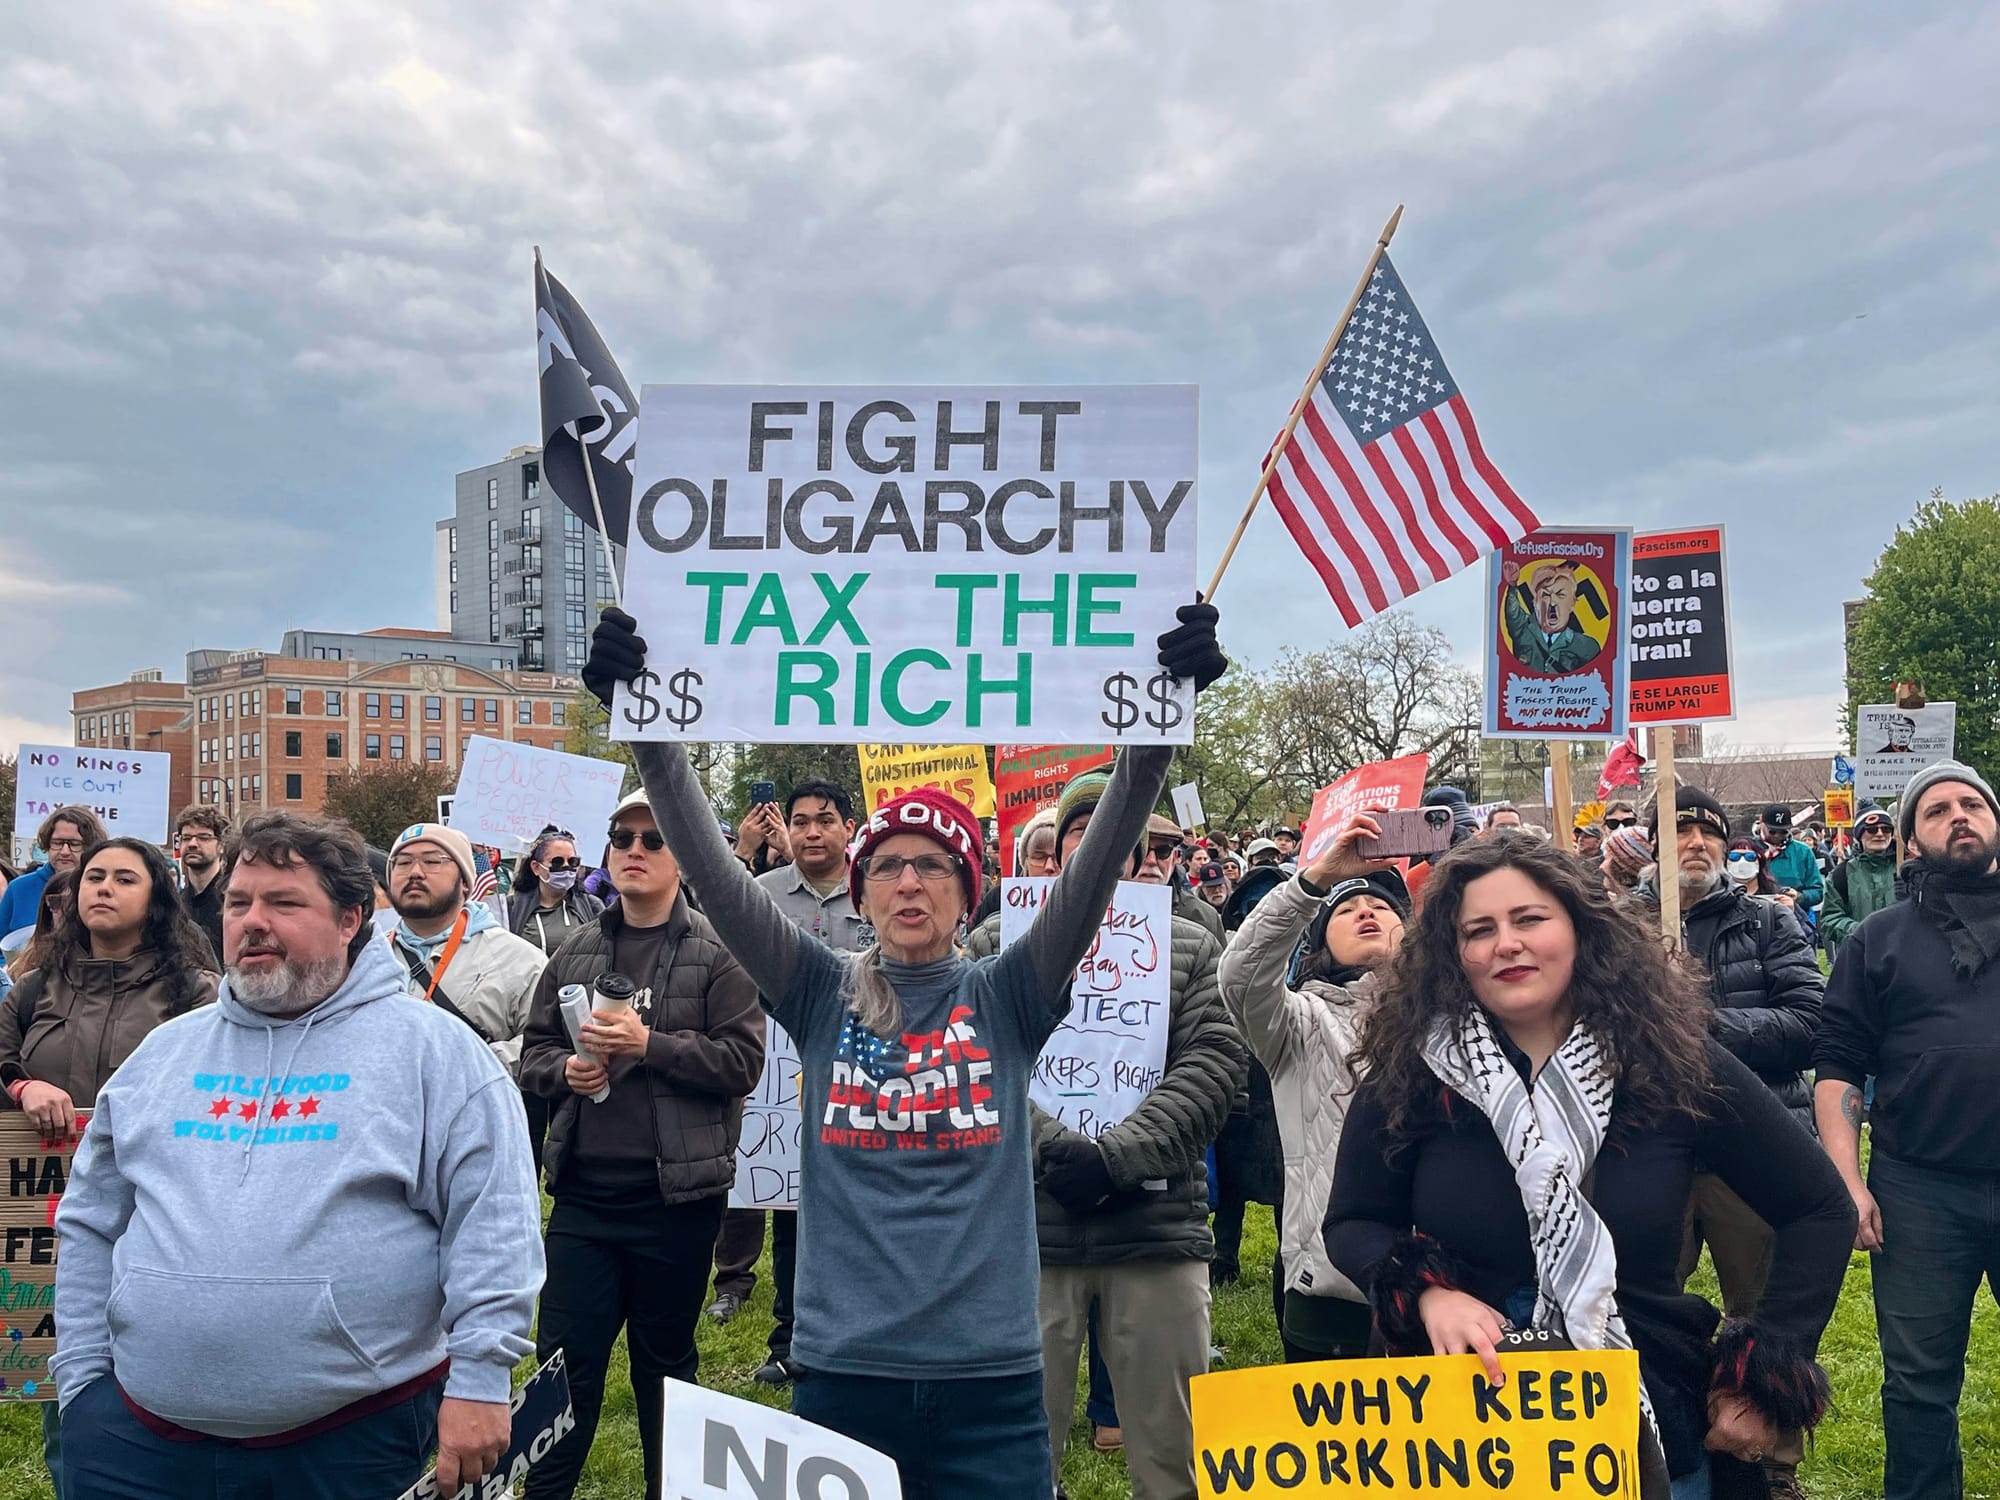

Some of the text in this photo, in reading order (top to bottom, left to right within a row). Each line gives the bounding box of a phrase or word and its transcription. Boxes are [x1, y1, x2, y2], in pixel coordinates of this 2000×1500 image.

[748, 400, 1081, 474] FIGHT
[636, 477, 1194, 555] OLIGARCHY
[1513, 541, 1604, 559] RefuseFascism.Org
[1666, 574, 1684, 591] a
[1690, 568, 1716, 588] la
[686, 571, 1137, 647] TAX THE
[623, 667, 704, 732] $$
[773, 647, 1033, 728] RICH
[1101, 670, 1183, 737] $$
[1514, 695, 1599, 707] FASCIST REGIME
[1522, 685, 1588, 696] THE TRUMP
[1643, 688, 1662, 699] SE
[1664, 683, 1720, 698] LARGUE
[1678, 697, 1701, 710] YA!
[1518, 706, 1592, 719] MUST GO NOW!
[1866, 713, 1904, 722] TRUMP
[31, 753, 143, 775] NO KINGS
[478, 743, 573, 797] POWER
[865, 753, 979, 784] CONSTITUTIONAL
[1034, 763, 1069, 780] RIGHTS
[45, 777, 123, 795] ICE OUT!
[476, 782, 561, 822] PEOPLE
[899, 801, 972, 854] OUT
[901, 1004, 992, 1074] THE
[823, 1060, 1000, 1133] PEOPLE
[820, 1125, 887, 1149] UNITED
[895, 1131, 929, 1150] WE
[935, 1126, 1003, 1151] STAND
[1292, 1369, 1608, 1427] WHY KEEP
[703, 1418, 870, 1500] NO
[1201, 1437, 1514, 1495] WORKING
